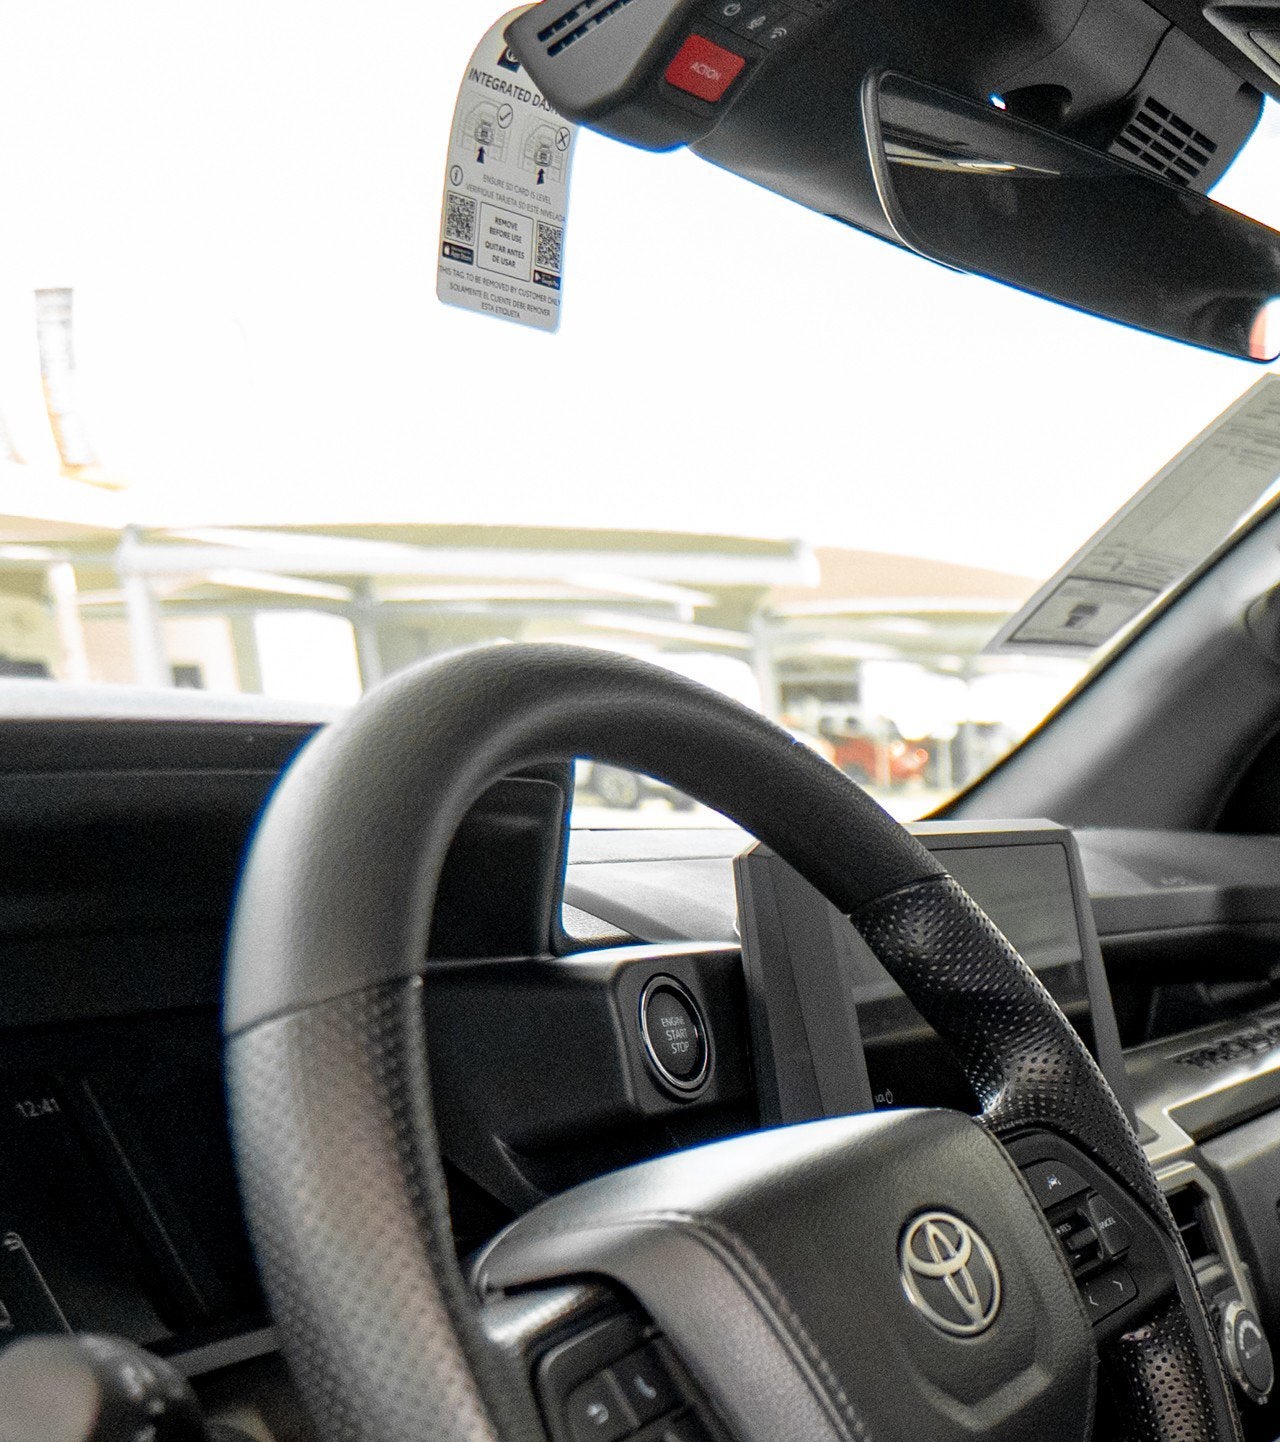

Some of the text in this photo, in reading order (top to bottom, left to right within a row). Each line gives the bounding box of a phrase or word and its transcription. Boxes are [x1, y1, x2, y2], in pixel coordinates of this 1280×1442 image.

[468, 68, 532, 103] INTEGRATED
[466, 183, 495, 199] VERIFIQUE
[496, 193, 517, 206] TARJETA
[483, 174, 505, 189] ENSURE
[514, 186, 530, 197] CARD
[536, 192, 552, 205] LEVEL
[494, 216, 519, 231] REMOVE
[489, 226, 522, 244] BEFORE USE
[485, 240, 506, 255] QUITAR
[507, 248, 525, 259] ANTES
[492, 254, 516, 268] DE USAR
[466, 273, 475, 282] TO
[482, 277, 510, 292] REMOVED
[510, 285, 518, 294] BY
[518, 288, 547, 303] CUSTOMER
[449, 282, 482, 299] SOLAMENTE
[490, 293, 512, 307] CLIENTE
[512, 299, 526, 311] DEBE
[526, 303, 551, 317] REMOVER
[481, 302, 521, 319] ESTA ETIQUETA
[660, 1015, 686, 1029] ENGINE
[666, 1028, 688, 1041] START
[671, 1041, 690, 1054] STOP
